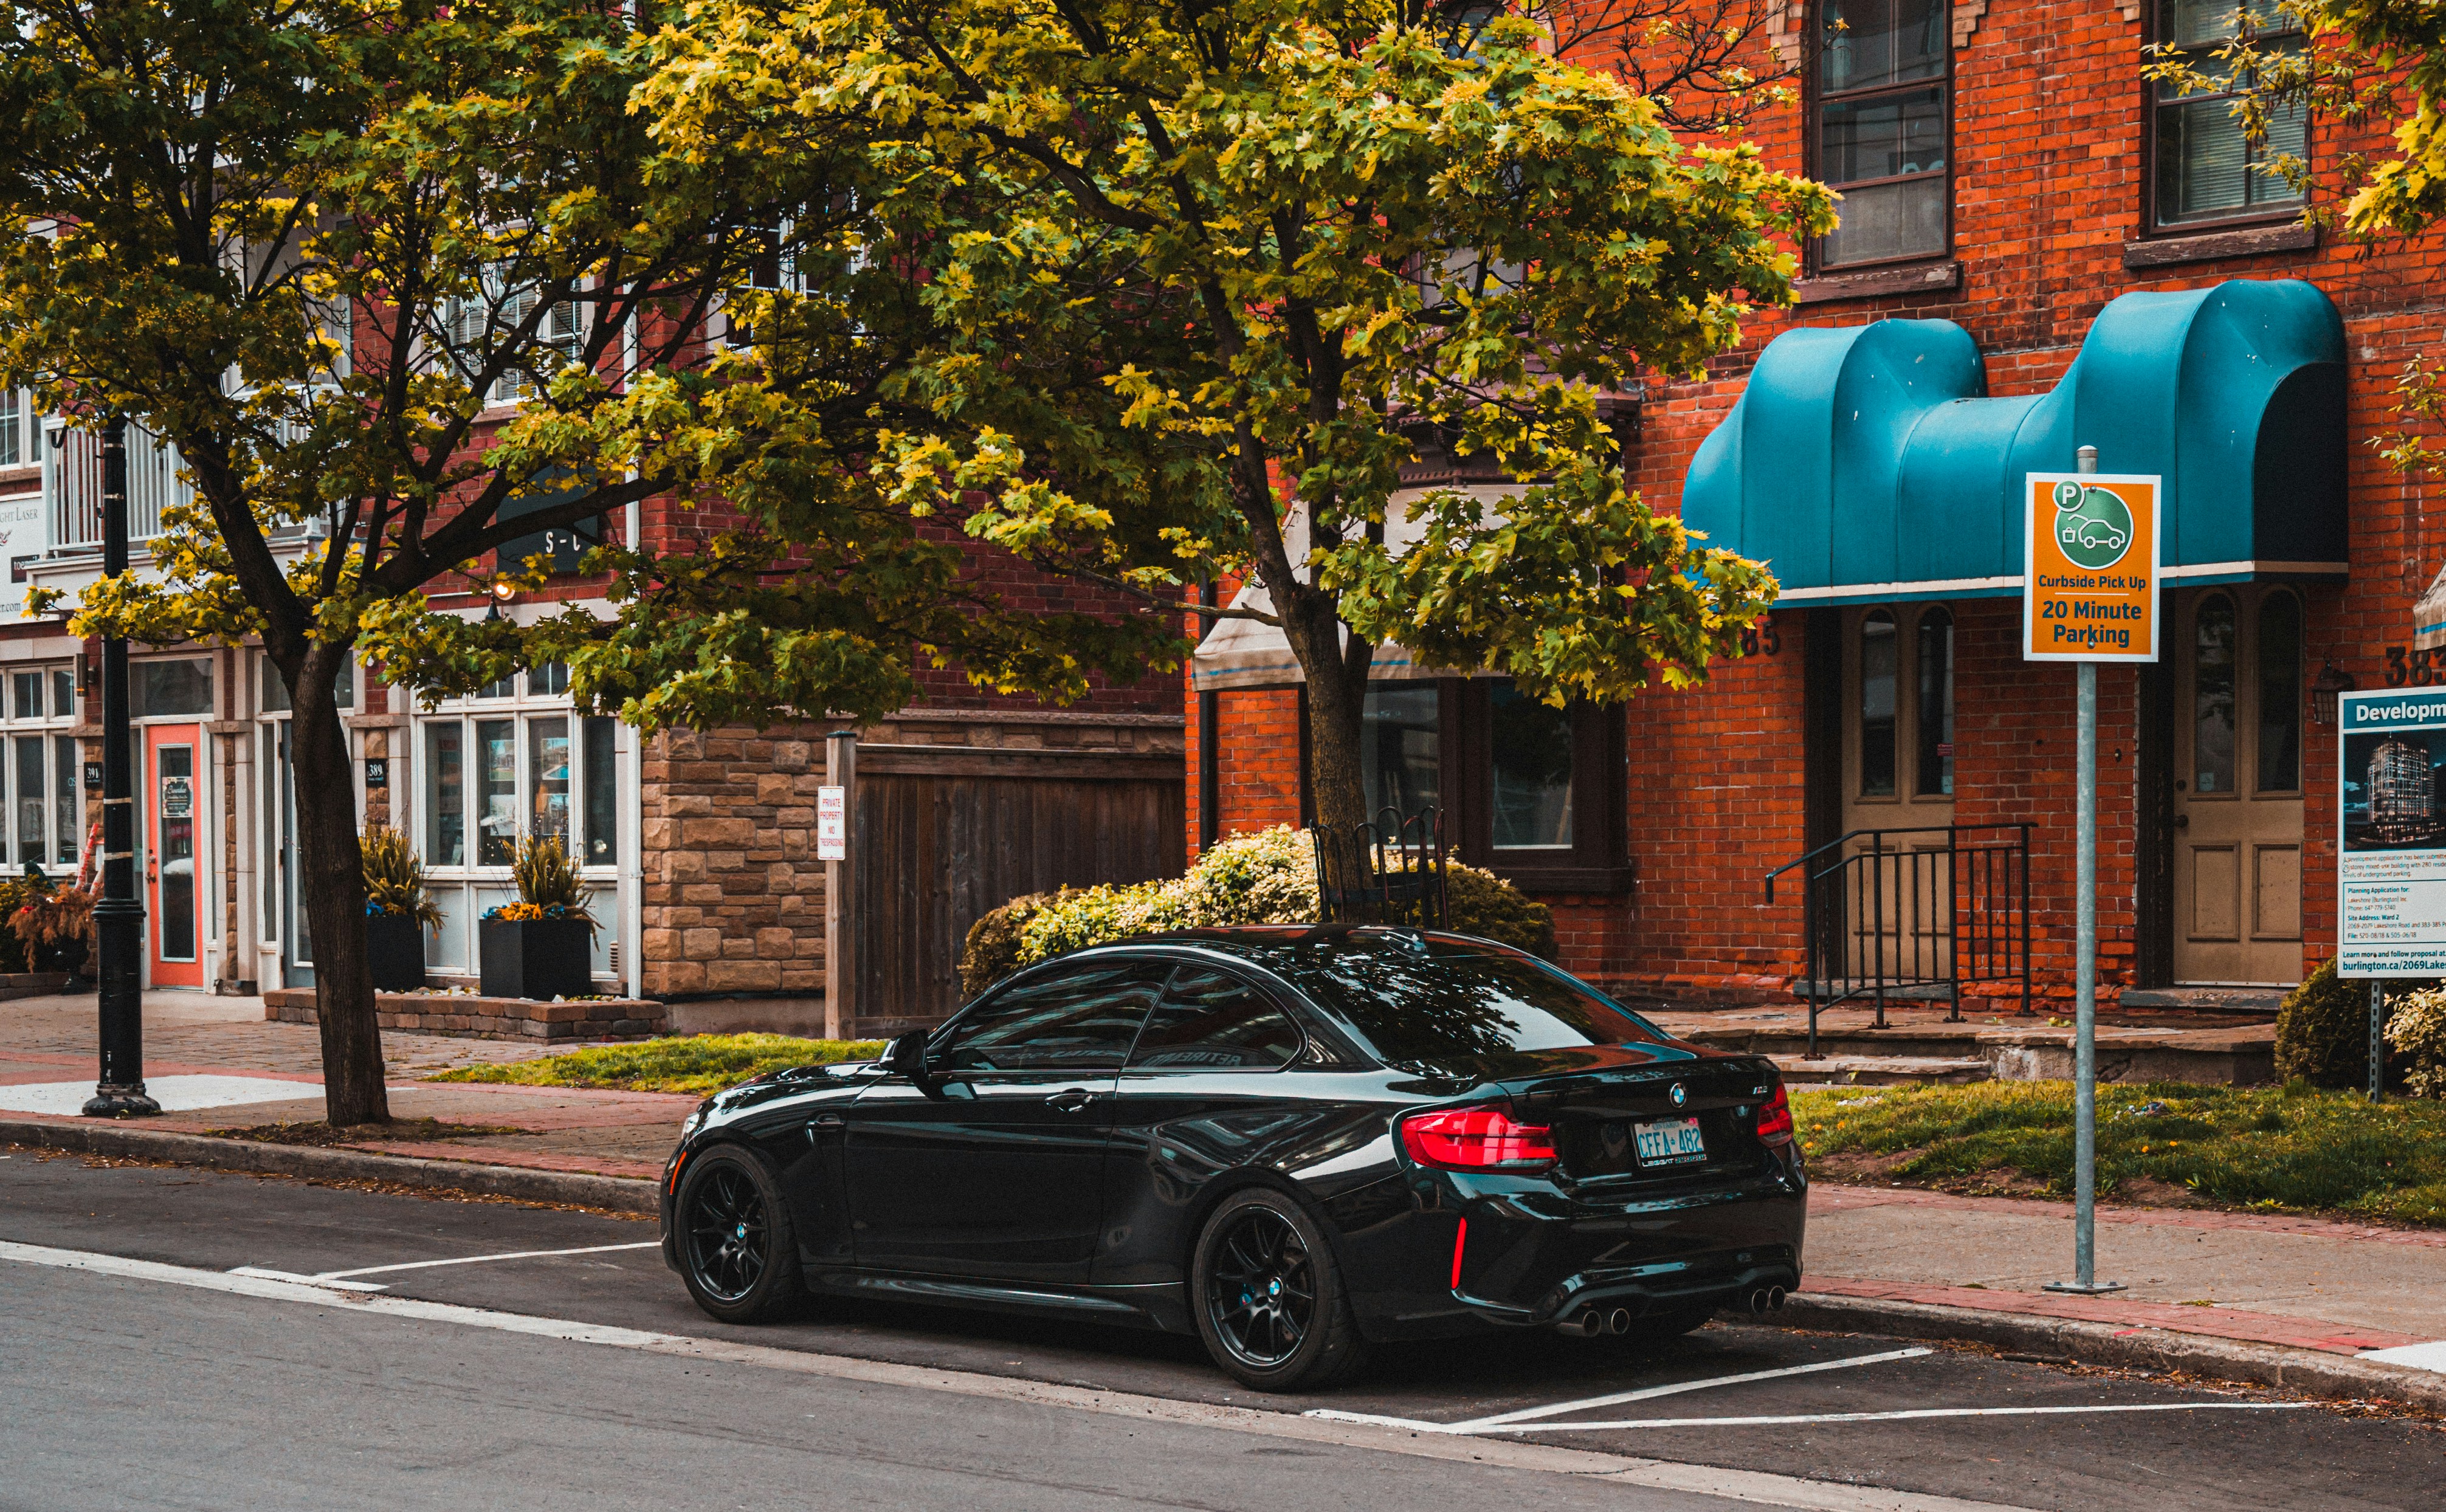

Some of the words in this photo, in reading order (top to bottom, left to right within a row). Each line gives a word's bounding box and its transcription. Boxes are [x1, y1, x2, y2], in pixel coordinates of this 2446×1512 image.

[2062, 485, 2077, 504] P
[2038, 575, 2095, 588] Curbside
[2099, 576, 2126, 588] Pick
[2129, 577, 2146, 592] Up
[2042, 600, 2067, 619] 20
[2074, 600, 2141, 619] Minute
[1740, 621, 1780, 656] 85
[2053, 624, 2129, 648] Parking
[88, 768, 98, 779] 391
[369, 764, 383, 777] 389
[2411, 950, 2437, 958] proposal
[1678, 1127, 1703, 1153] 482
[1642, 1158, 1675, 1167] LEGGAT
